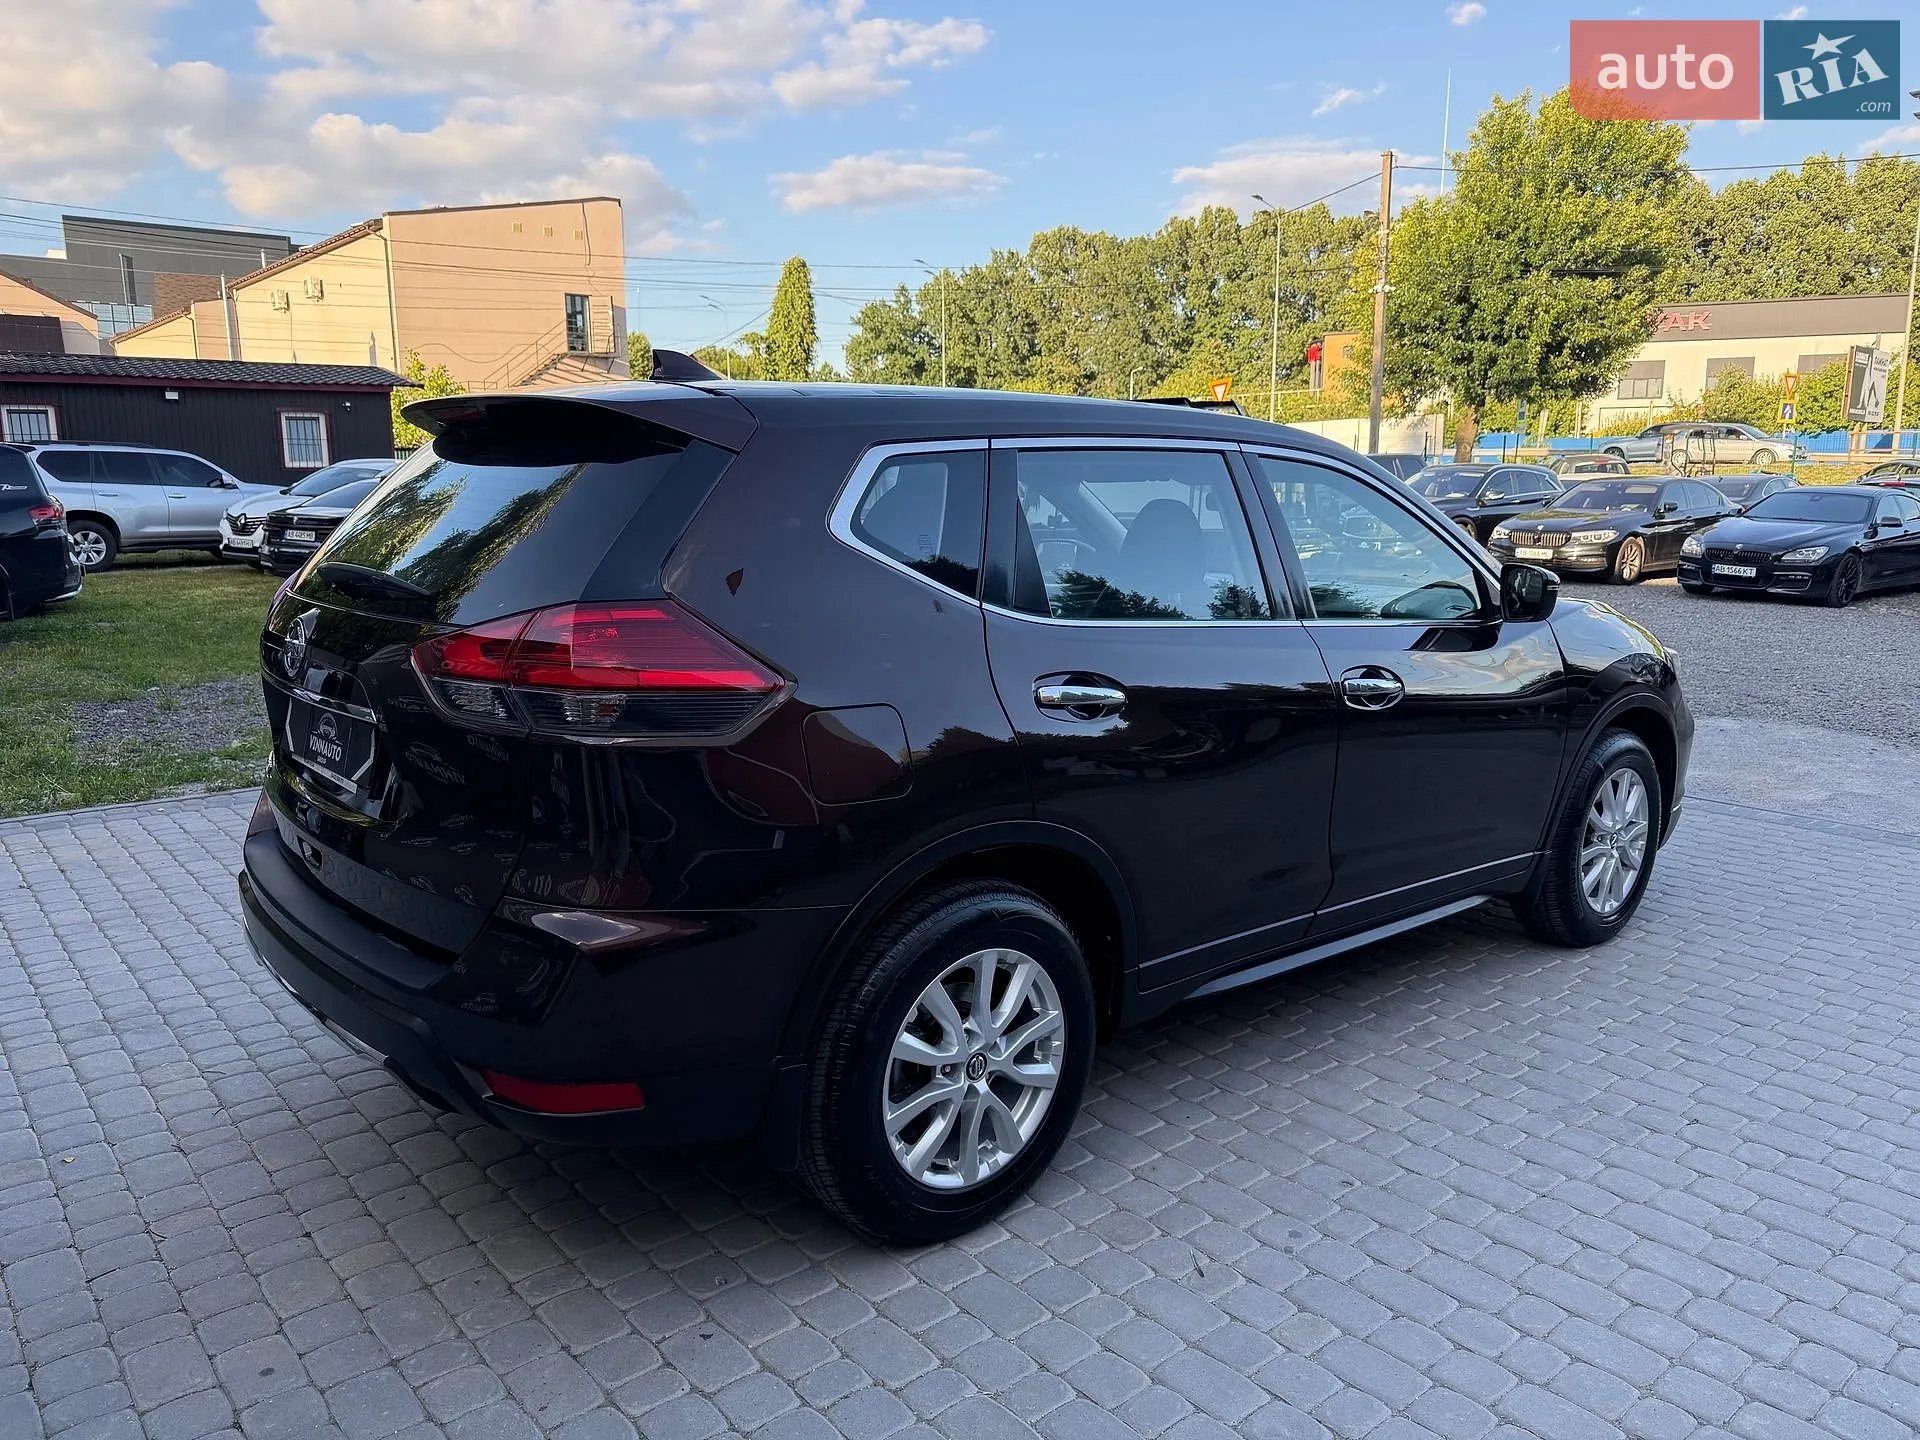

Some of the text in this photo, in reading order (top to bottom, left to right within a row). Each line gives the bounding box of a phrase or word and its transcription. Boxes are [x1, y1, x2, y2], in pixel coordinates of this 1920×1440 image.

[1715, 565, 1725, 573] AB
[1743, 568, 1755, 576] KT
[309, 734, 342, 762] VINNAUTO
